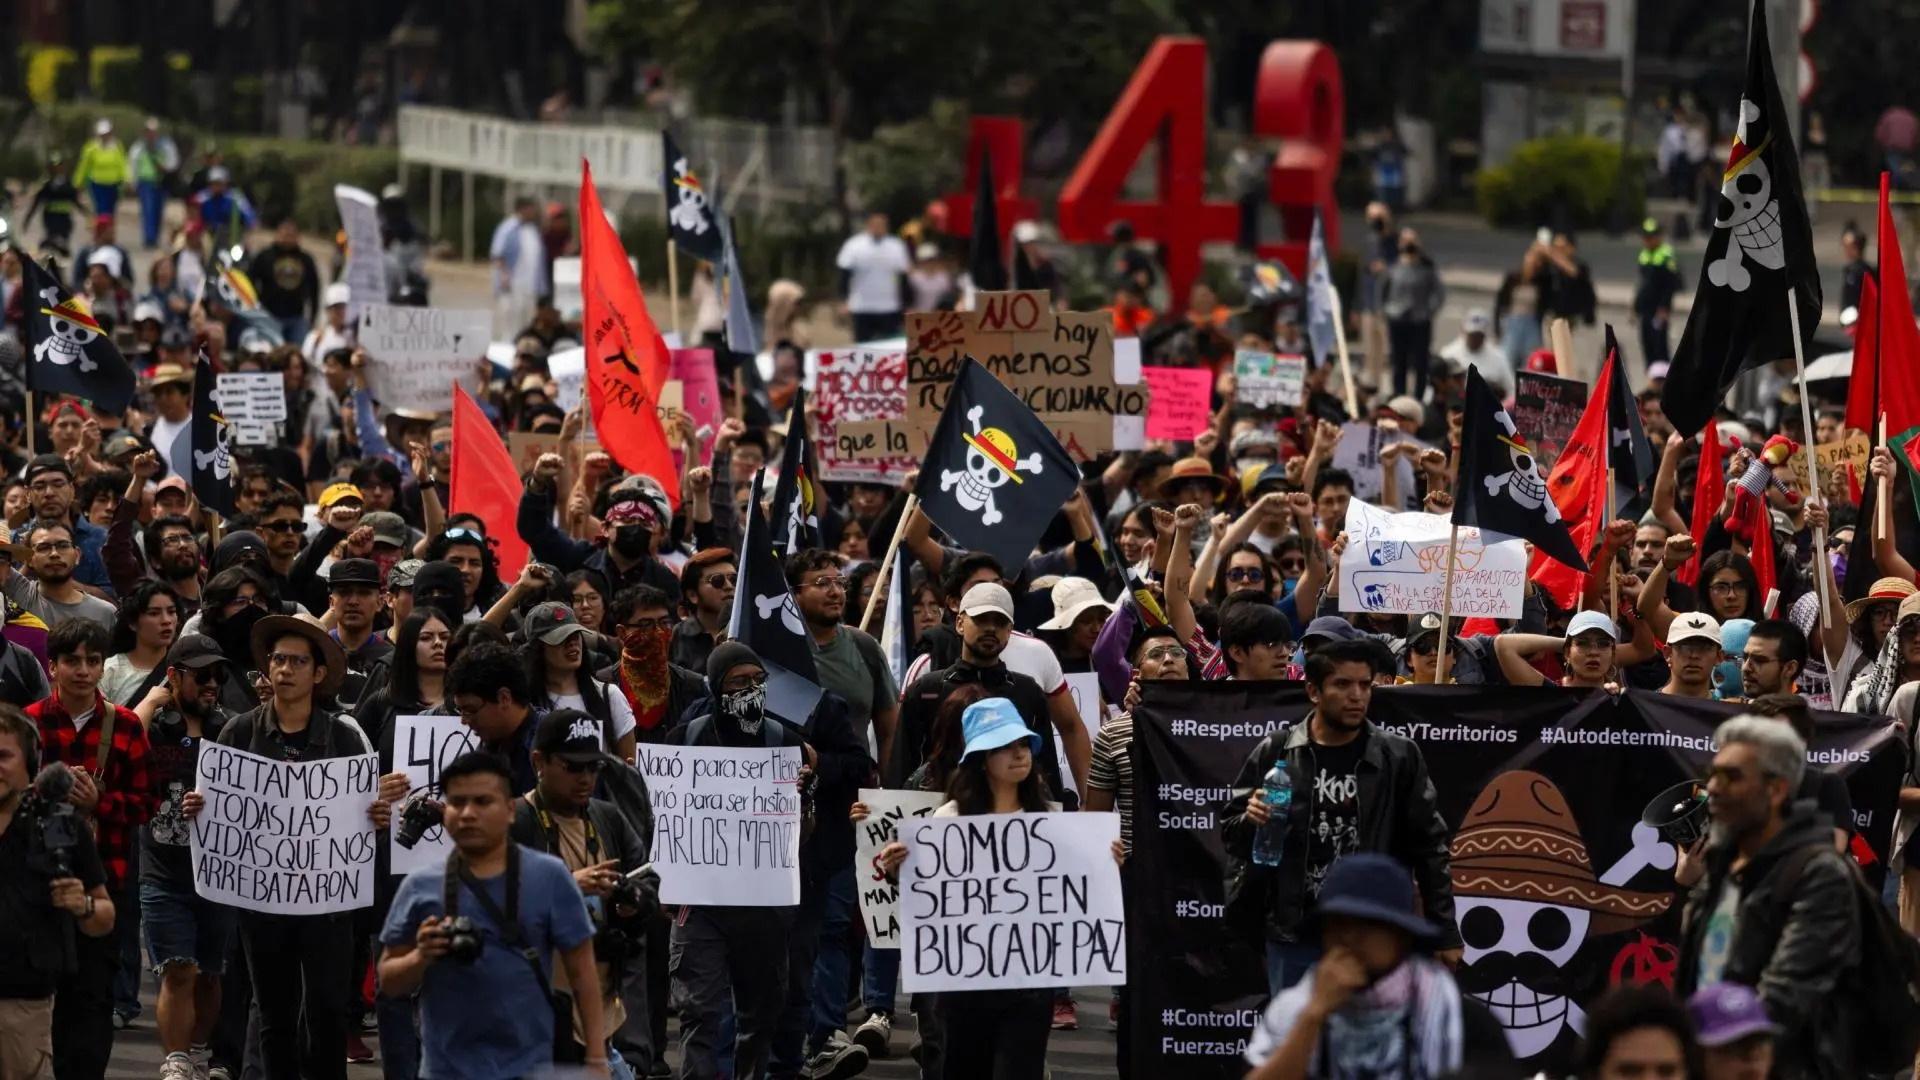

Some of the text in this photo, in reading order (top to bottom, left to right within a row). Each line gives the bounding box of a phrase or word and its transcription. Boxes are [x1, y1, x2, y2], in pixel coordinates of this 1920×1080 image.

[978, 292, 1039, 330] NO
[1054, 315, 1099, 357] hay
[908, 349, 1091, 379] nad menos
[839, 433, 876, 460] que
[886, 422, 908, 453] la
[1464, 569, 1523, 587] PARASITOS
[200, 747, 380, 800] GRITAMOS POR
[638, 748, 683, 778] Nació
[693, 758, 736, 788] para
[739, 758, 769, 779] ser
[209, 787, 330, 836] TODAS LAS
[684, 790, 722, 818] para
[726, 793, 749, 812] ser
[1157, 783, 1232, 807] #Seguri
[1158, 811, 1215, 830] Social
[194, 816, 374, 871] VIDAS QUE NOS
[739, 819, 796, 870] MANZ
[915, 817, 1056, 879] SOMOS
[197, 853, 360, 904] ARREBATARON
[911, 874, 1088, 919] SERES EN
[1073, 918, 1124, 976] PAZ
[1162, 1037, 1250, 1056] FuerzasA
